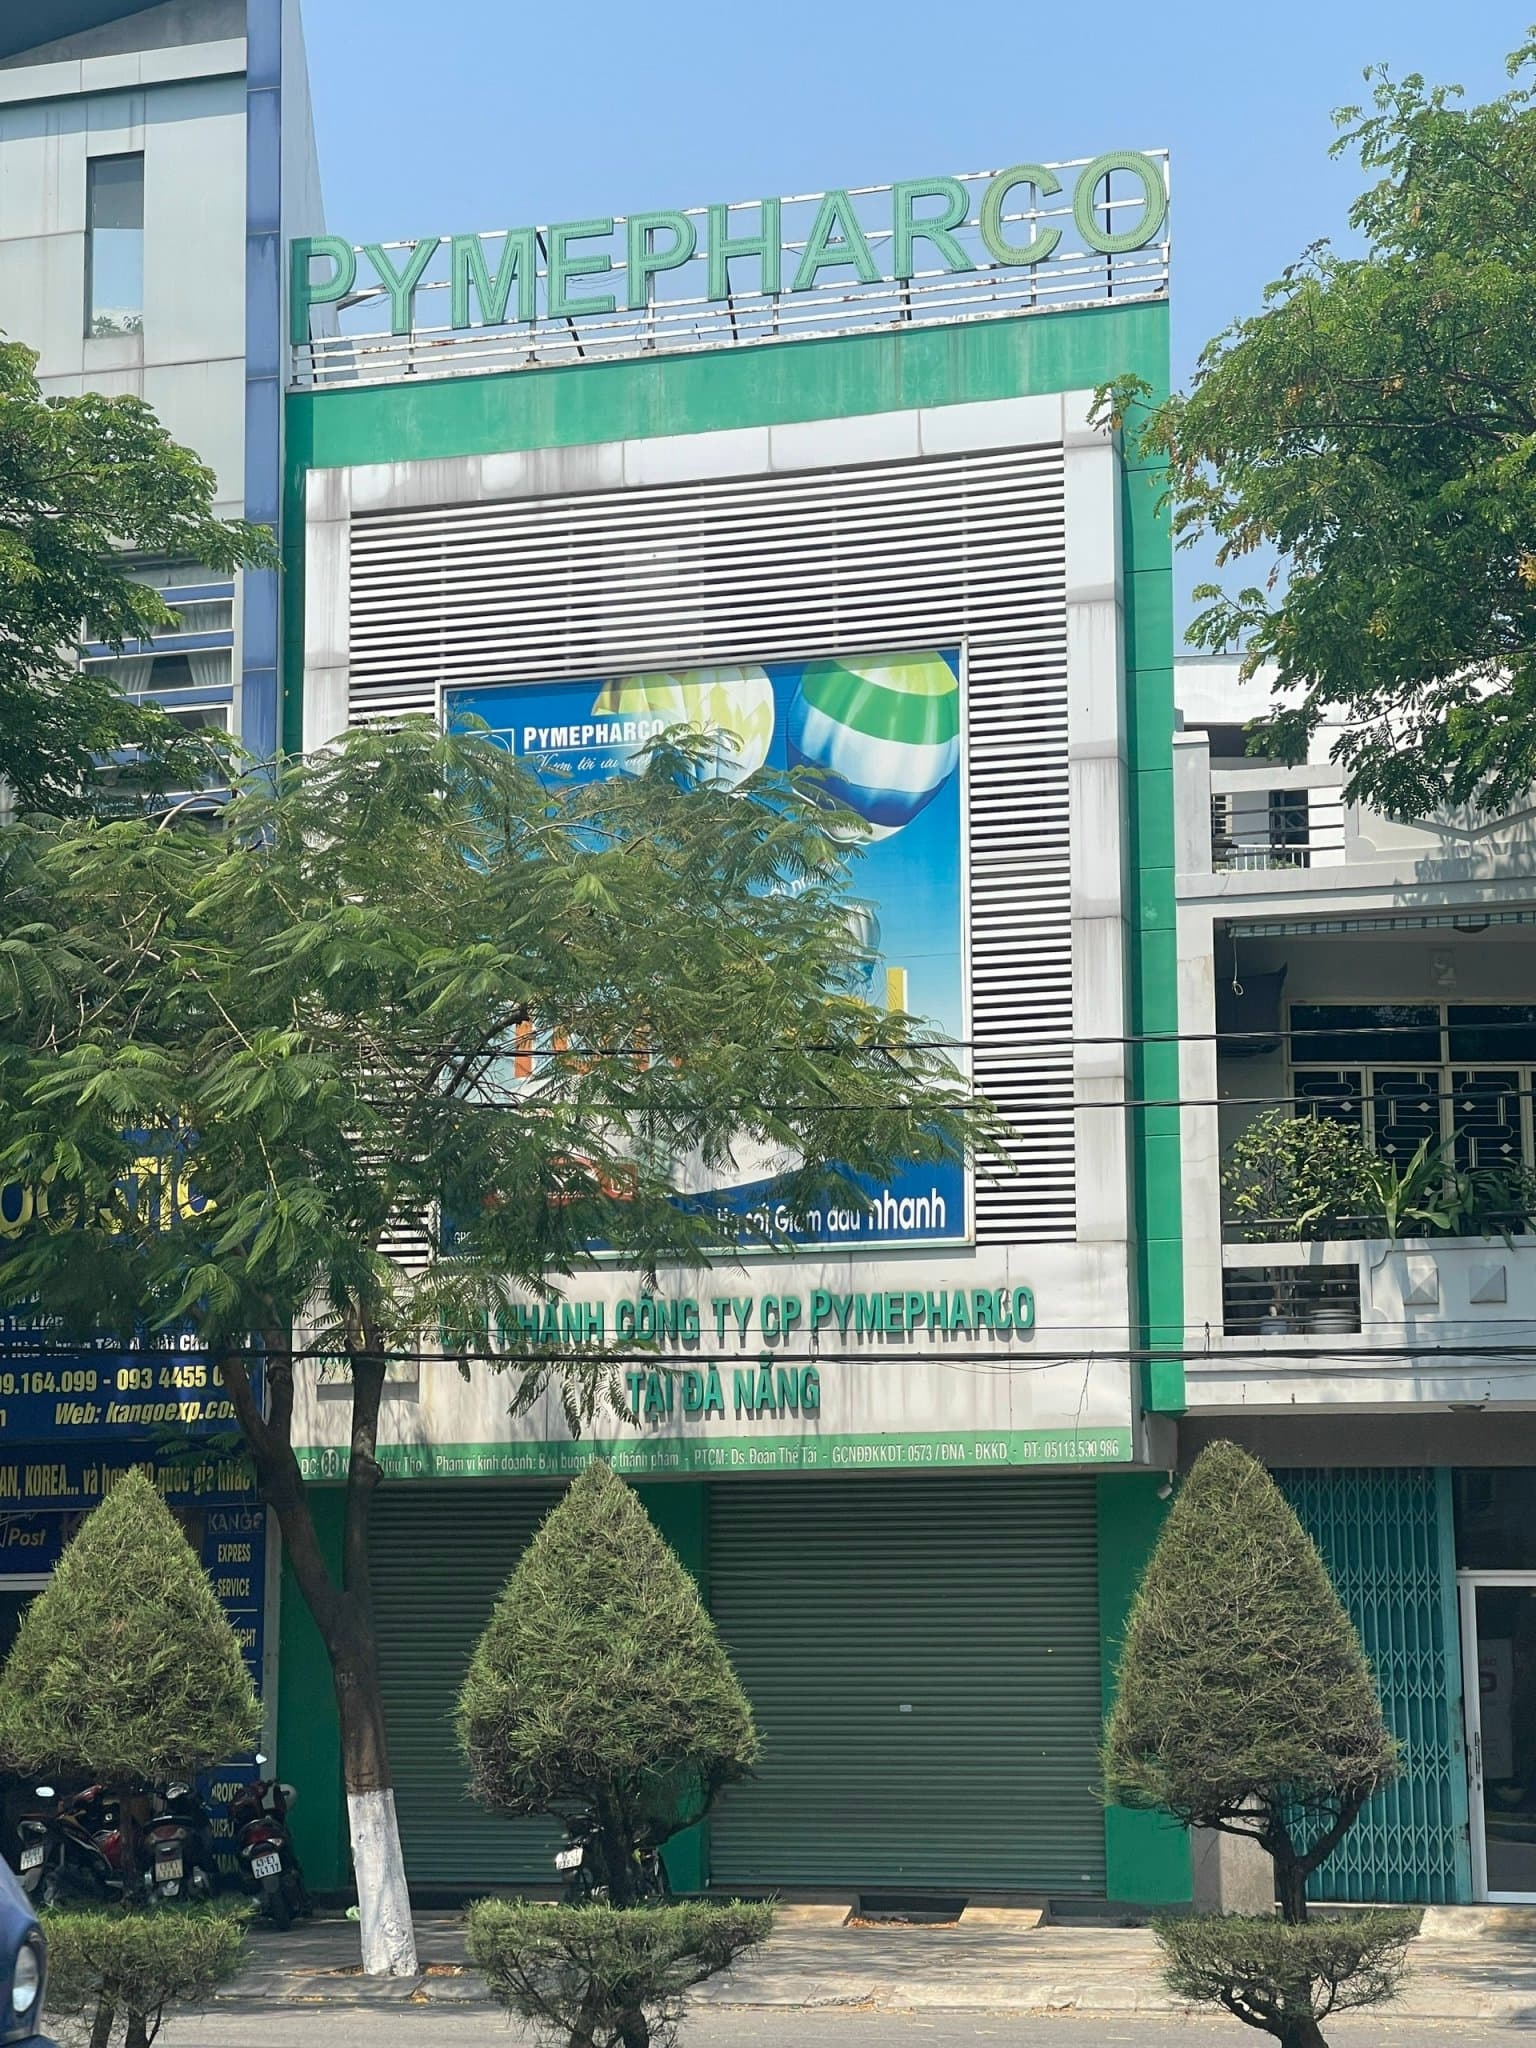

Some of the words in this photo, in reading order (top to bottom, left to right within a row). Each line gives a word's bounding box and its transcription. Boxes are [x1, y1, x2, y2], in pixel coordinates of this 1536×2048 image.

[288, 150, 1166, 345] PYMEPHARCO
[524, 718, 664, 751] PYMEPHARCO
[868, 1187, 946, 1230] nhanh
[615, 1289, 700, 1340] CÔNG
[712, 1296, 754, 1338] TY
[760, 1293, 802, 1337] CP
[810, 1285, 1036, 1333] PYMEPHARCO
[117, 1367, 152, 1391] 093
[158, 1365, 207, 1389] 4455
[627, 1369, 674, 1421] TẠI
[682, 1361, 726, 1412] ĐÀ
[55, 1402, 102, 1425] Web:
[477, 1453, 498, 1470] kinh
[500, 1453, 537, 1471] doanh:
[24, 1463, 79, 1497] KOREA...
[83, 1461, 98, 1496] và
[7, 1527, 47, 1547] Post
[217, 1543, 252, 1563] EXPRESS
[216, 1577, 251, 1597] SERVICE
